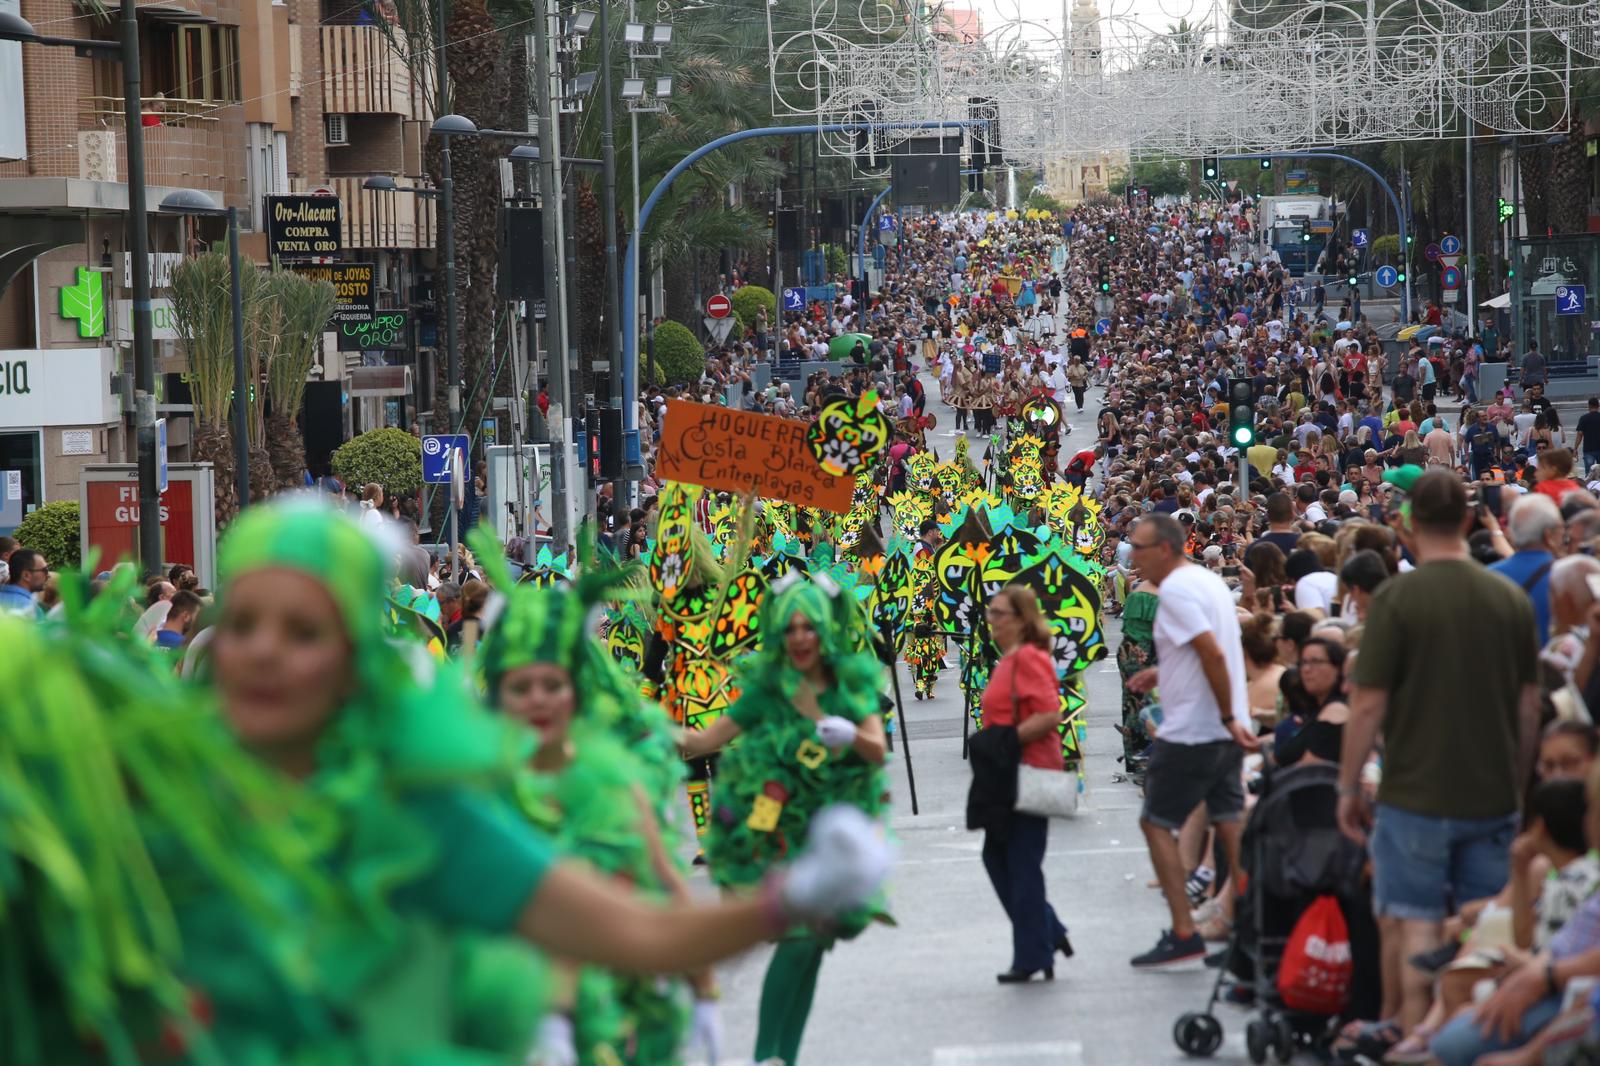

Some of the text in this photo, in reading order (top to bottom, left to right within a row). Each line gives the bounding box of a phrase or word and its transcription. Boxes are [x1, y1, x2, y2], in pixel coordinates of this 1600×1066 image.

[275, 203, 336, 222] Oro-Alacant
[285, 227, 329, 237] COMPRA
[277, 242, 337, 252] VENTA ORO
[345, 268, 371, 280] JOYAS
[360, 328, 393, 348] ORO
[700, 411, 807, 453] HOGUERA
[680, 426, 747, 461] Costa
[763, 444, 837, 489] Blanca
[700, 460, 815, 500] Entreplayas
[115, 506, 169, 523] GUS
